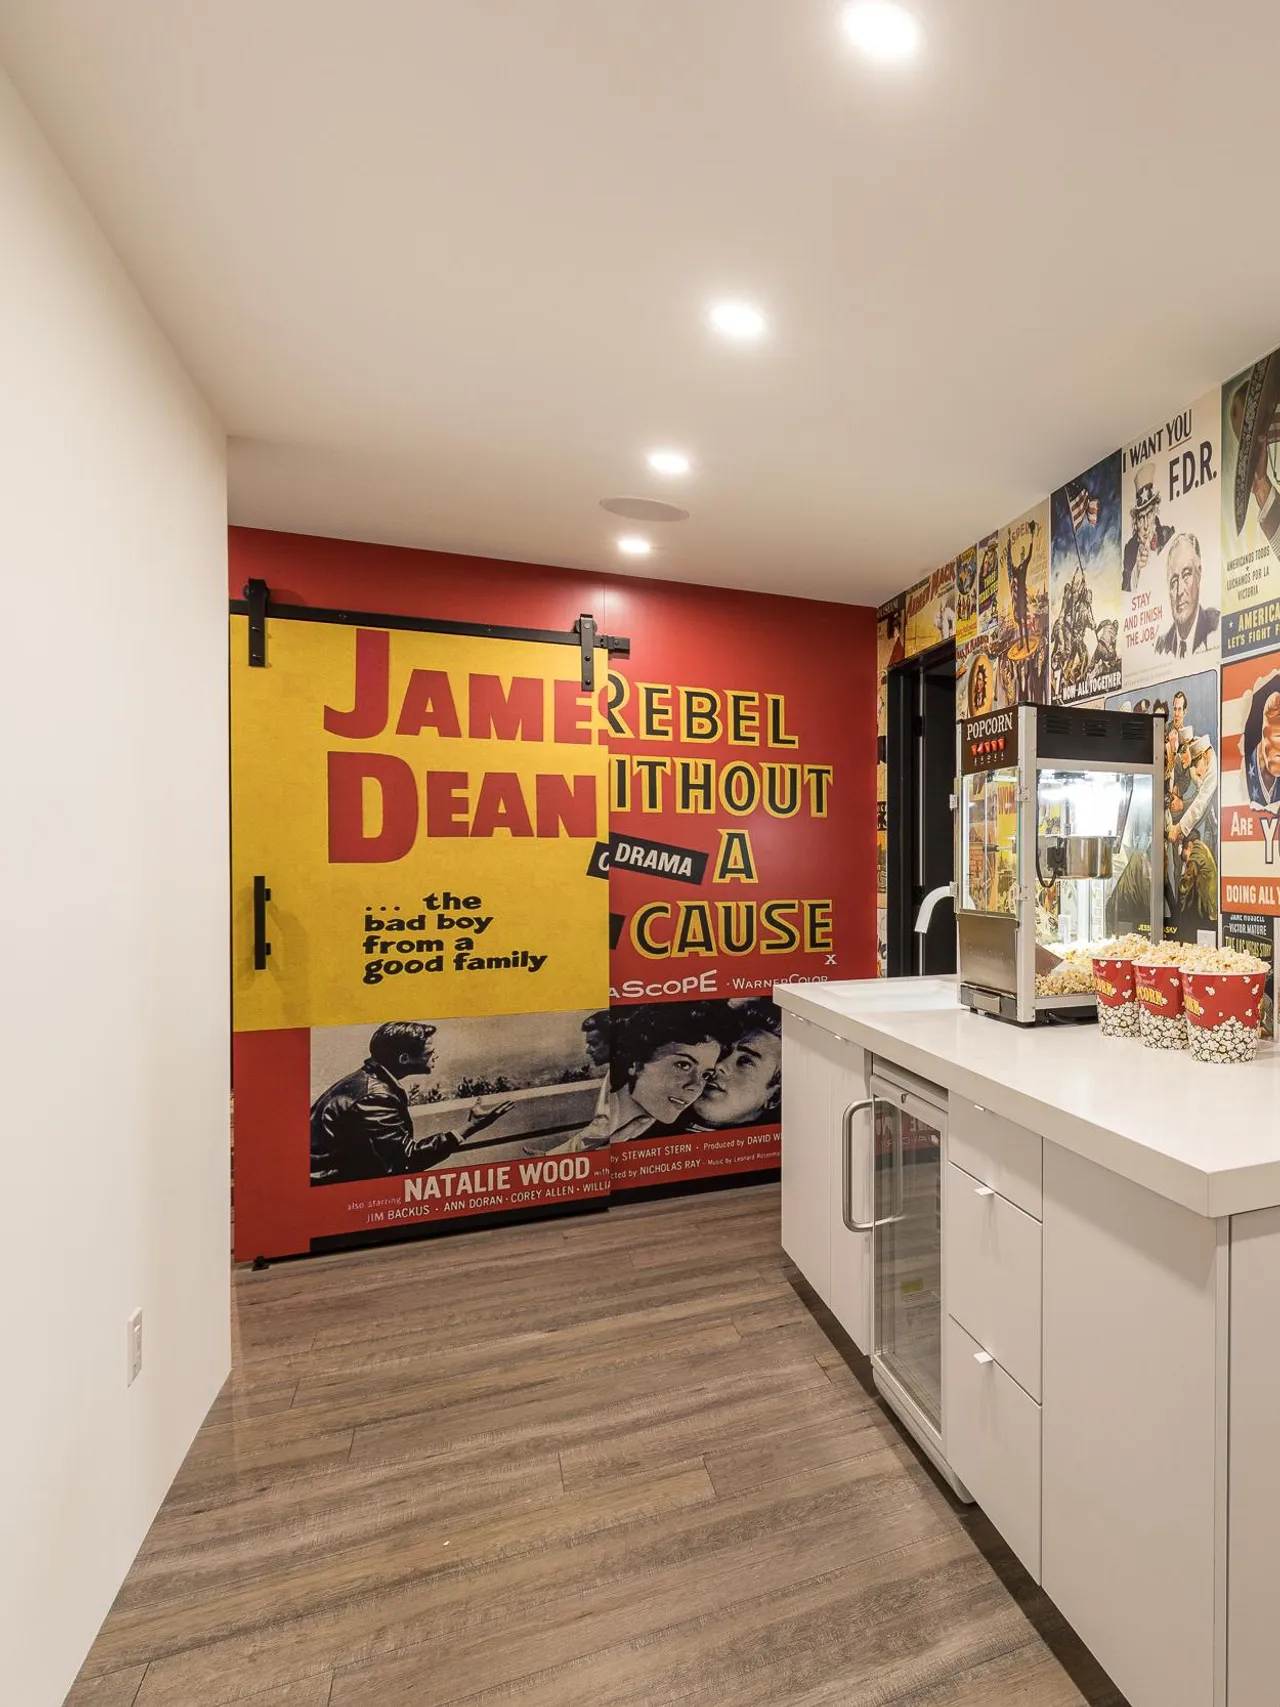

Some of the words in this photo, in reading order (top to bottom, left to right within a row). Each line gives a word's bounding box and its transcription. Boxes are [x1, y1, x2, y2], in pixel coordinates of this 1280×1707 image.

[1123, 452, 1127, 474] I
[1129, 428, 1164, 468] WANT
[1166, 408, 1192, 447] YOU
[1169, 440, 1218, 502] F.D.R.
[1226, 549, 1254, 572] AMERICANOS
[1255, 545, 1270, 561] TODOS
[1263, 565, 1270, 577] LA
[1131, 591, 1152, 611] STAY
[1124, 615, 1138, 632] AND
[1139, 605, 1163, 626] FINISH
[1126, 630, 1139, 649] THE
[1140, 624, 1159, 648] JOB!
[1227, 634, 1246, 650] LET'S
[1248, 626, 1271, 643] FIGHT
[1089, 671, 1122, 694] TOGETHER
[607, 668, 799, 749] REBEL
[966, 712, 1013, 741] POPCORN
[607, 753, 833, 819] ITHOUT
[328, 750, 598, 864] DEAN
[614, 842, 693, 877] DRAMA
[712, 829, 759, 884] A
[422, 891, 483, 911] the
[1226, 884, 1257, 904] DOING
[1258, 885, 1275, 905] ALL
[364, 914, 426, 932] bad
[436, 913, 494, 934] boy
[630, 899, 833, 960] CAUSE
[1228, 922, 1246, 933] VICTOR
[1246, 924, 1267, 936] MATURE
[362, 935, 444, 954] from
[454, 936, 474, 951] a
[362, 955, 444, 985] good
[453, 950, 548, 973] family
[610, 1154, 619, 1164] by
[621, 1145, 661, 1162] STEWART
[664, 1143, 692, 1157] STERN
[703, 1138, 735, 1151] Produced
[736, 1139, 745, 1148] by
[747, 1134, 771, 1145] DAVID
[628, 1169, 638, 1178] by
[639, 1161, 683, 1176] NICHOLAS
[684, 1159, 701, 1170] RAY
[347, 1202, 365, 1211] also
[404, 1167, 512, 1203] NATALIE
[519, 1157, 590, 1186] WOOD
[365, 1212, 384, 1224] JIM
[387, 1204, 431, 1220] BACKUS
[443, 1200, 466, 1213] ANN
[469, 1195, 503, 1209] DORAN
[510, 1189, 542, 1203] COREY
[545, 1185, 574, 1198] ALLEN
